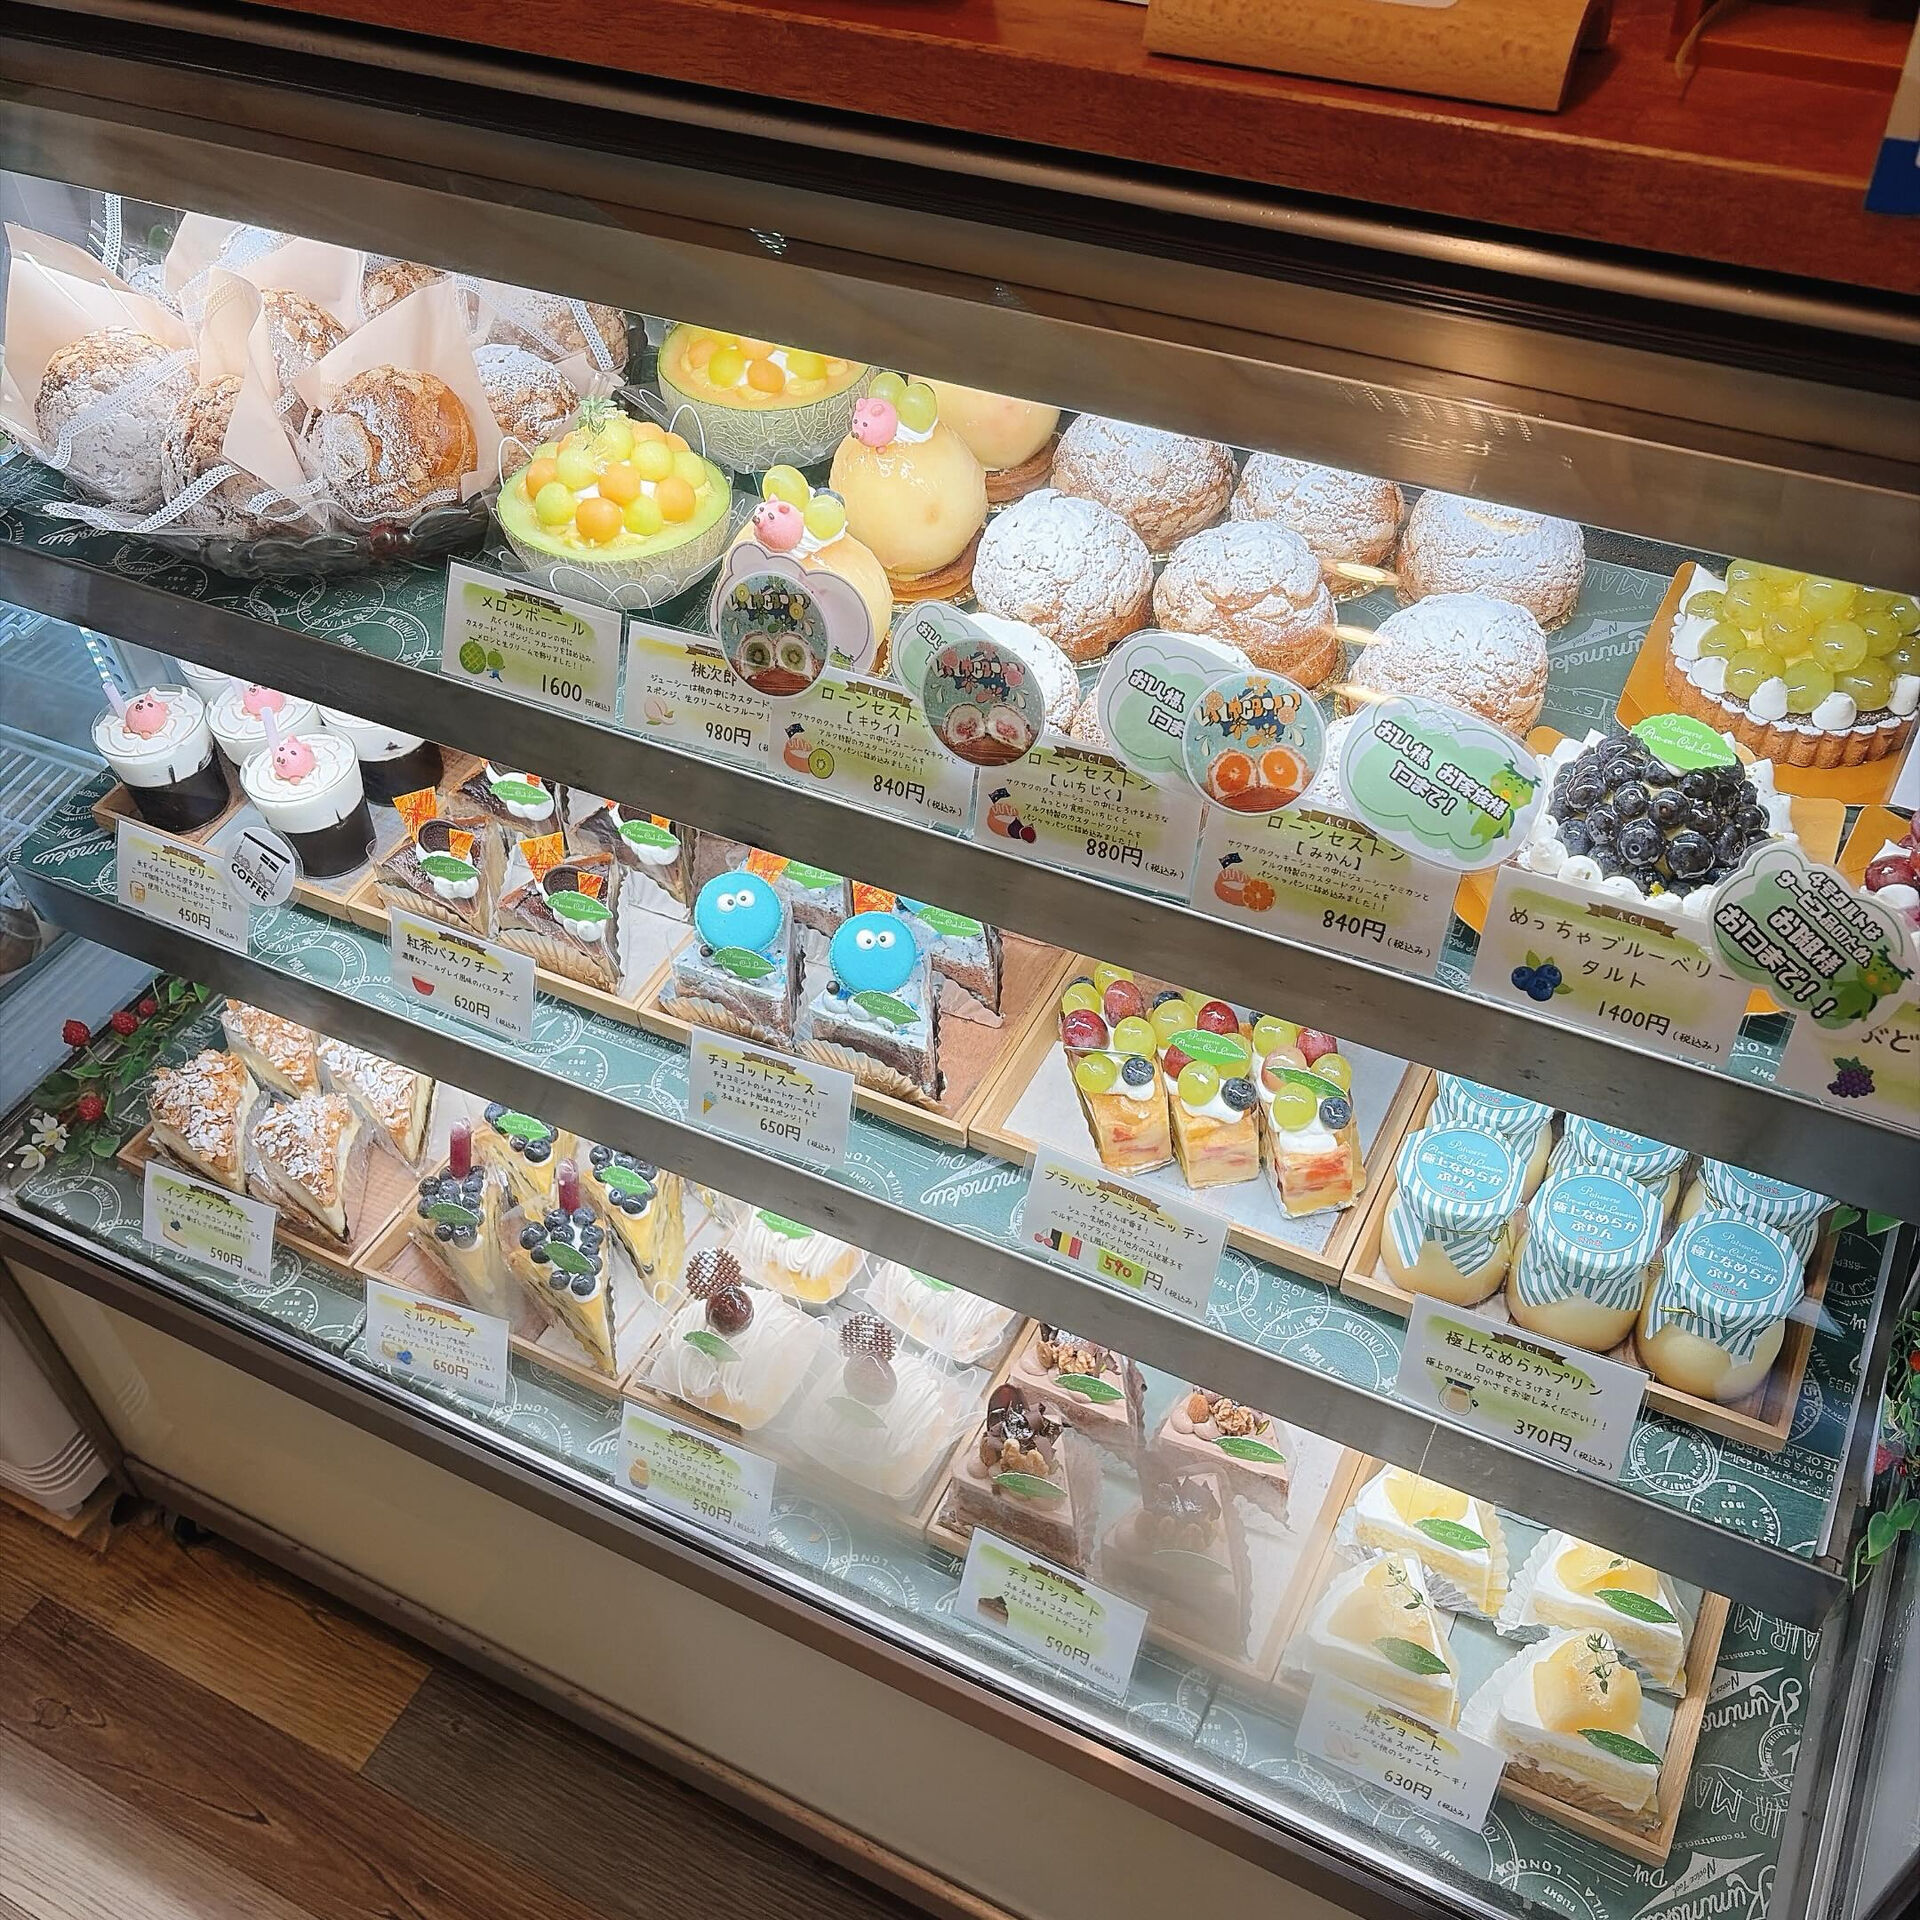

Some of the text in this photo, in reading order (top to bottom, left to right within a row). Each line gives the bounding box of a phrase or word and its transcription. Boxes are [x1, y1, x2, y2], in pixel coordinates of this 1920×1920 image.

[541, 674, 583, 703] 1600
[691, 661, 738, 687] 桃次郎
[706, 722, 752, 748] 980円
[873, 774, 926, 805] 840円
[1323, 816, 1354, 832] A.C.L
[151, 851, 216, 881] コーヒーゼリー
[1085, 838, 1144, 869] 880円
[1295, 841, 1363, 871] 【みかん】
[231, 861, 270, 902] COFFEE
[178, 907, 211, 930] 450円
[1322, 909, 1432, 959] 840円 (税込み)
[1615, 910, 1647, 928] A.C.L
[406, 933, 514, 985] 紅茶バスクチーズ
[1508, 906, 1736, 982] めっちゃブルーベリー
[1581, 959, 1648, 989] タルト
[454, 994, 490, 1019] 620円
[1598, 1000, 1721, 1054] 1400円 (税込み)
[707, 1053, 829, 1097] チョコットスースー
[759, 1117, 801, 1142] 650円
[1044, 1169, 1209, 1245] ブラバンターシュニッテン
[1552, 1200, 1638, 1233] 極上なめらか
[210, 1246, 243, 1269] 590円
[1690, 1244, 1778, 1286] 極上なめらか
[1143, 1270, 1164, 1291] 円
[403, 1308, 475, 1338] ミルクレープ
[433, 1359, 469, 1380] 650円
[1445, 1330, 1604, 1397] 極上なめらかプリン
[1475, 1362, 1561, 1401] 口の中でとろける！
[666, 1434, 725, 1465] モンブラン
[1513, 1418, 1573, 1453] 370円
[692, 1497, 732, 1524] 590円
[1008, 1566, 1100, 1617] チョコショート
[1044, 1635, 1090, 1666] 590円
[1364, 1710, 1443, 1752] 桃ショート
[1384, 1770, 1433, 1801] 630円
